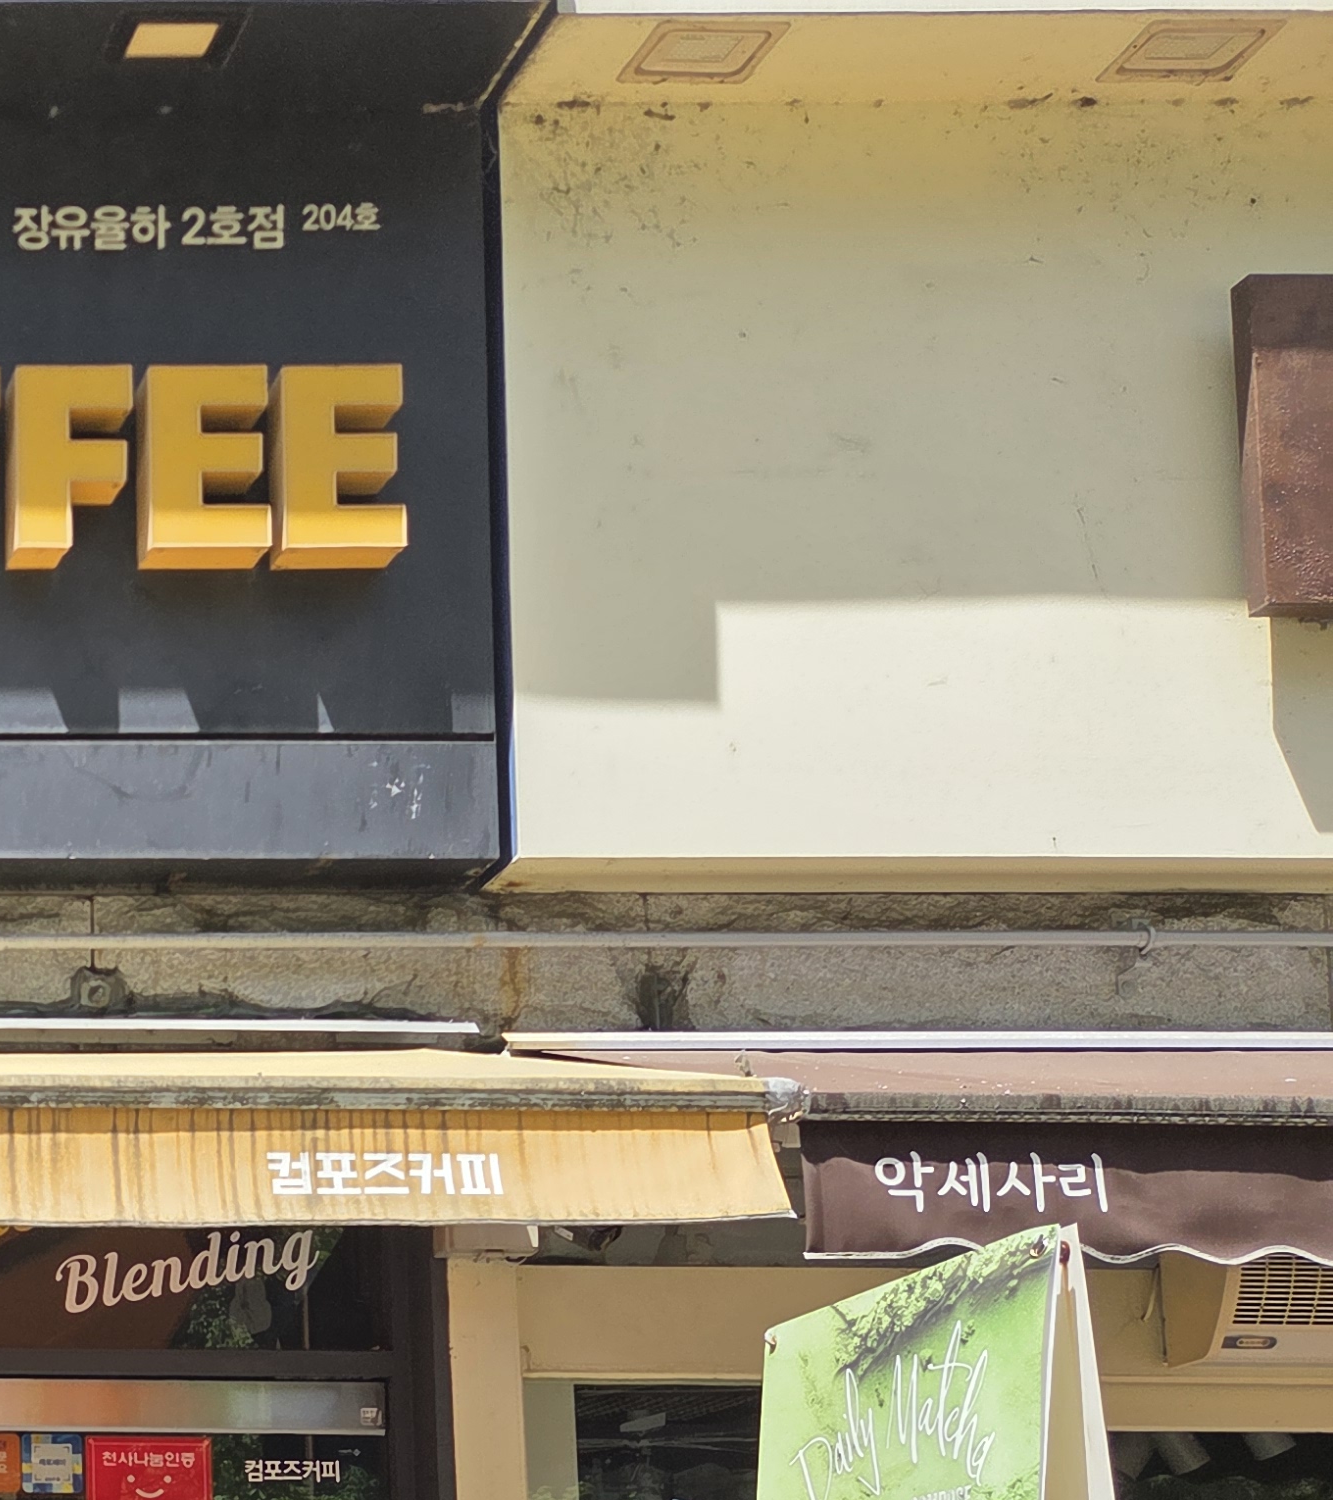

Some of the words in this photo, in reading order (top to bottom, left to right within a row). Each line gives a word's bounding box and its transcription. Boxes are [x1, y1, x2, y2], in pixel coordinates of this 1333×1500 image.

[12, 203, 170, 250] 장유율하
[181, 205, 286, 250] 2호점
[301, 201, 380, 231] 204호
[265, 1150, 505, 1197] 컴포즈커피
[875, 1150, 1109, 1214] 악세사리
[55, 1228, 322, 1315] Blending
[886, 1320, 996, 1487] Matcha
[244, 1459, 340, 1483] 컴포즈커피
